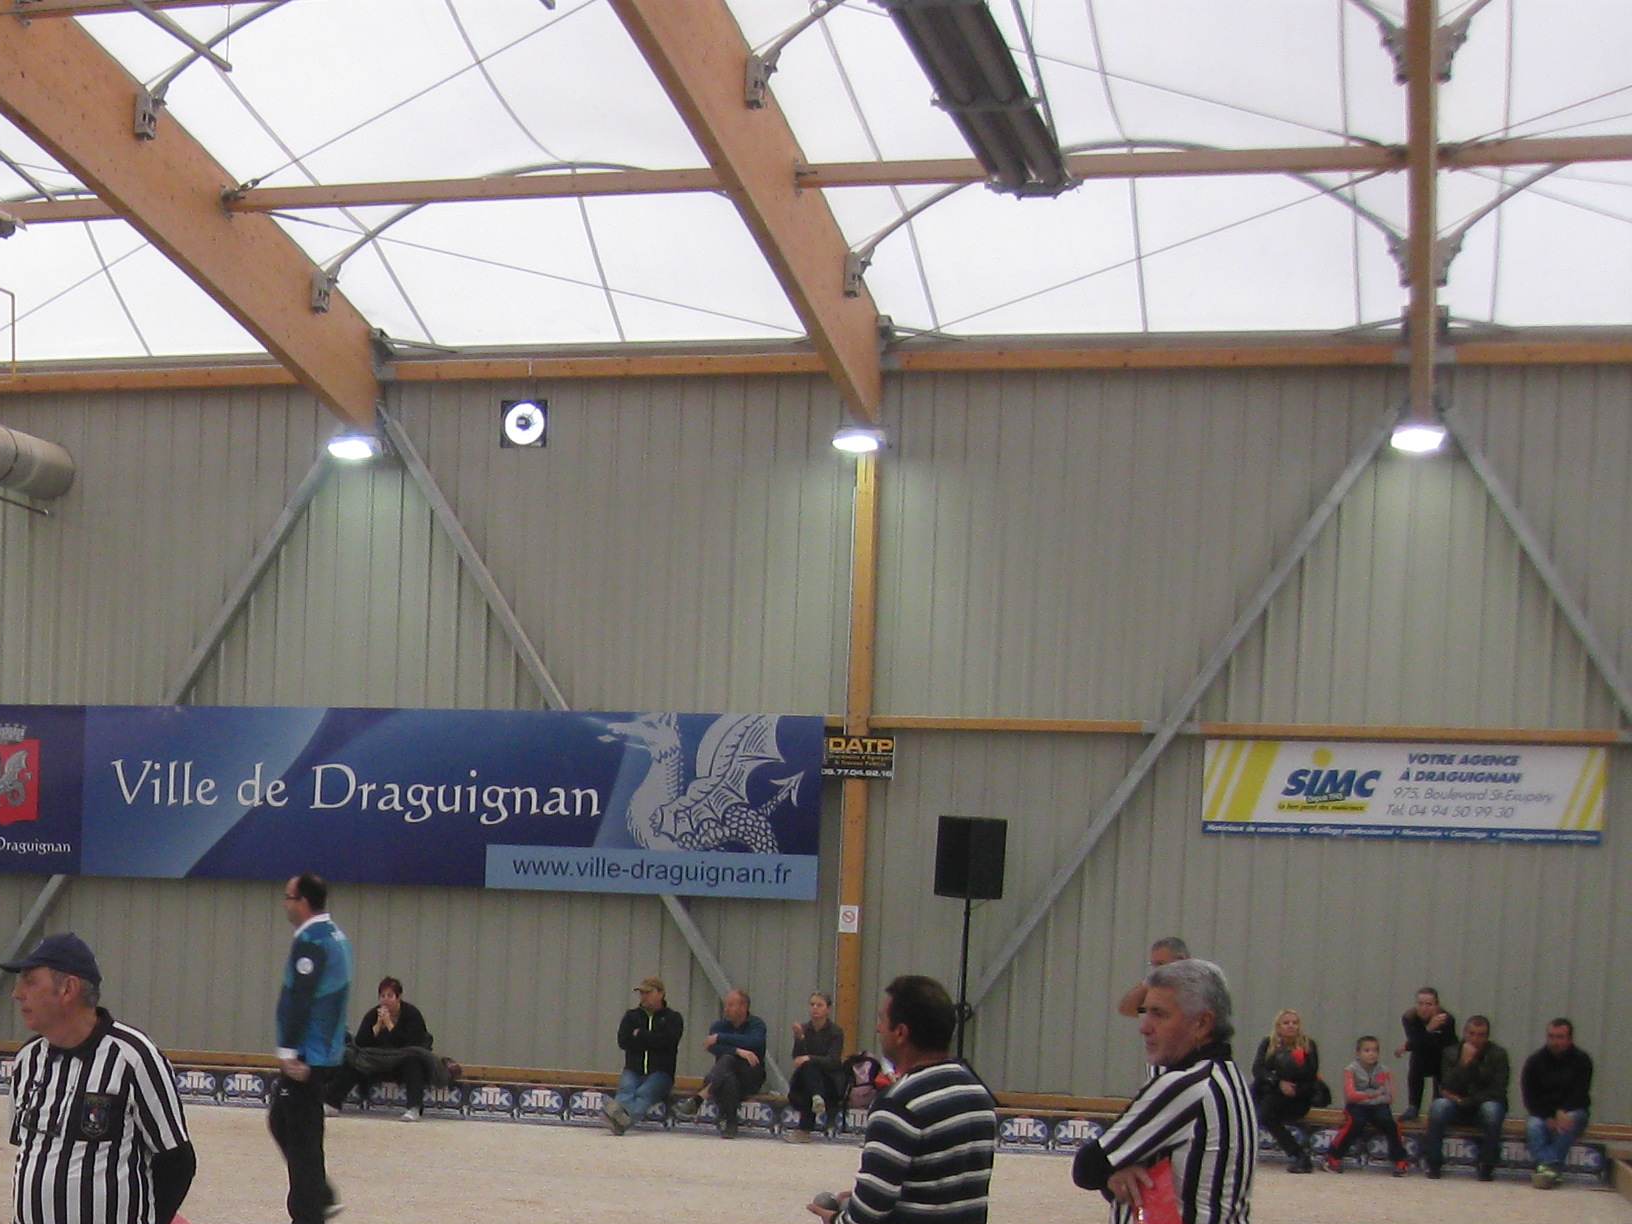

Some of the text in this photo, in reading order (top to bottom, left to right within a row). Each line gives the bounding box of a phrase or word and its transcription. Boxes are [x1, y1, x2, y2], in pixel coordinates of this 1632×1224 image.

[829, 737, 894, 752] DATP
[1408, 753, 1520, 767] VOTRE AGENCE
[1414, 770, 1523, 784] DRAGUIGNAN
[111, 758, 601, 825] Ville de Draguignan
[1423, 787, 1488, 801] Boulevard
[1408, 804, 1427, 817] 04
[1430, 805, 1448, 817] 94
[1451, 805, 1470, 818] 50
[1474, 806, 1492, 818] 99
[1494, 806, 1514, 819] 30
[513, 856, 792, 887] www.ville-draguignan.fr
[471, 1086, 512, 1107] KTK
[520, 1088, 560, 1108] KTK
[1004, 1117, 1044, 1138] KTK
